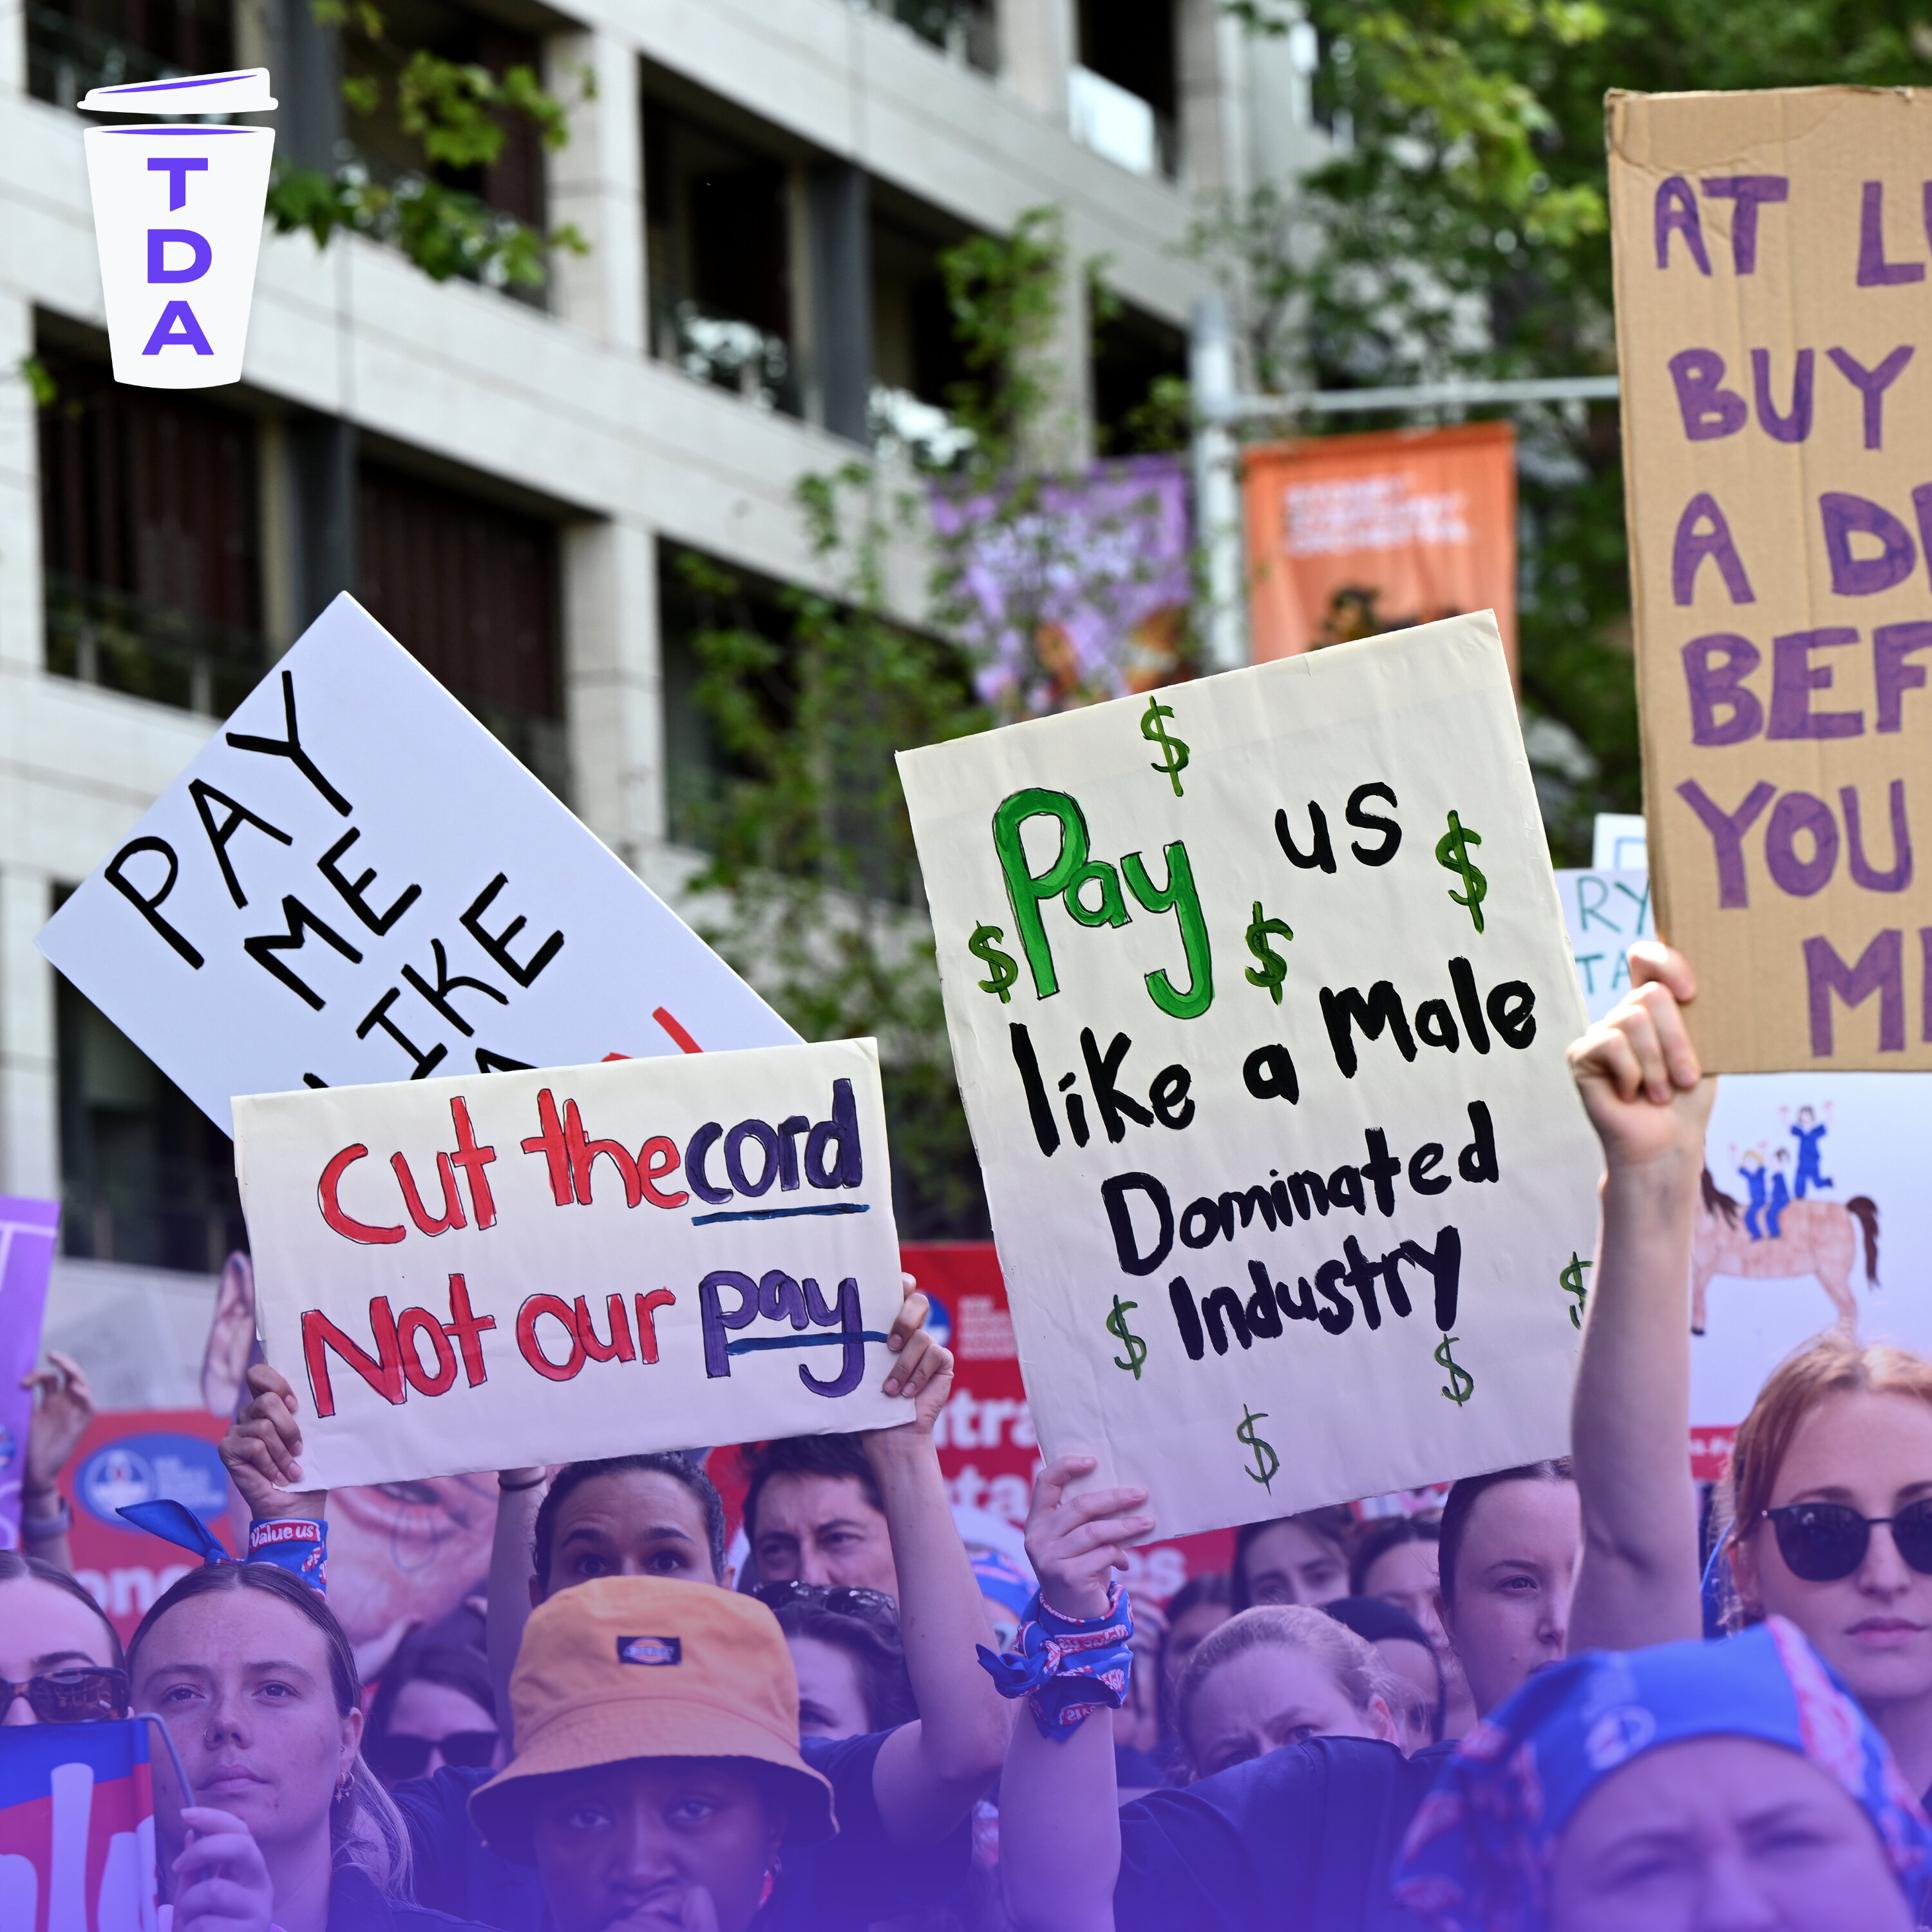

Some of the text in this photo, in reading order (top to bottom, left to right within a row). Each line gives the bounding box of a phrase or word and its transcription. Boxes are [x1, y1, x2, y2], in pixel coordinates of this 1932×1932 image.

[1655, 175, 1932, 287] AT L
[1668, 345, 1915, 450] BUY
[1672, 482, 1932, 606] A D
[104, 670, 353, 970] PAY
[1676, 778, 1913, 909] YOU
[243, 826, 422, 1012] ME
[992, 781, 1403, 1020] Pay us
[303, 872, 565, 1089] IKE
[1242, 1043, 1300, 1106] a
[1319, 956, 1537, 1079] Male
[1803, 927, 1932, 1057] M
[317, 1095, 497, 1245] Cut
[1101, 1100, 1500, 1276] Dominated
[301, 1273, 496, 1419] Not
[516, 1286, 676, 1383] our
[698, 1269, 866, 1398] pay
[1168, 1225, 1462, 1361] Industry
[251, 1524, 314, 1548] Value us
